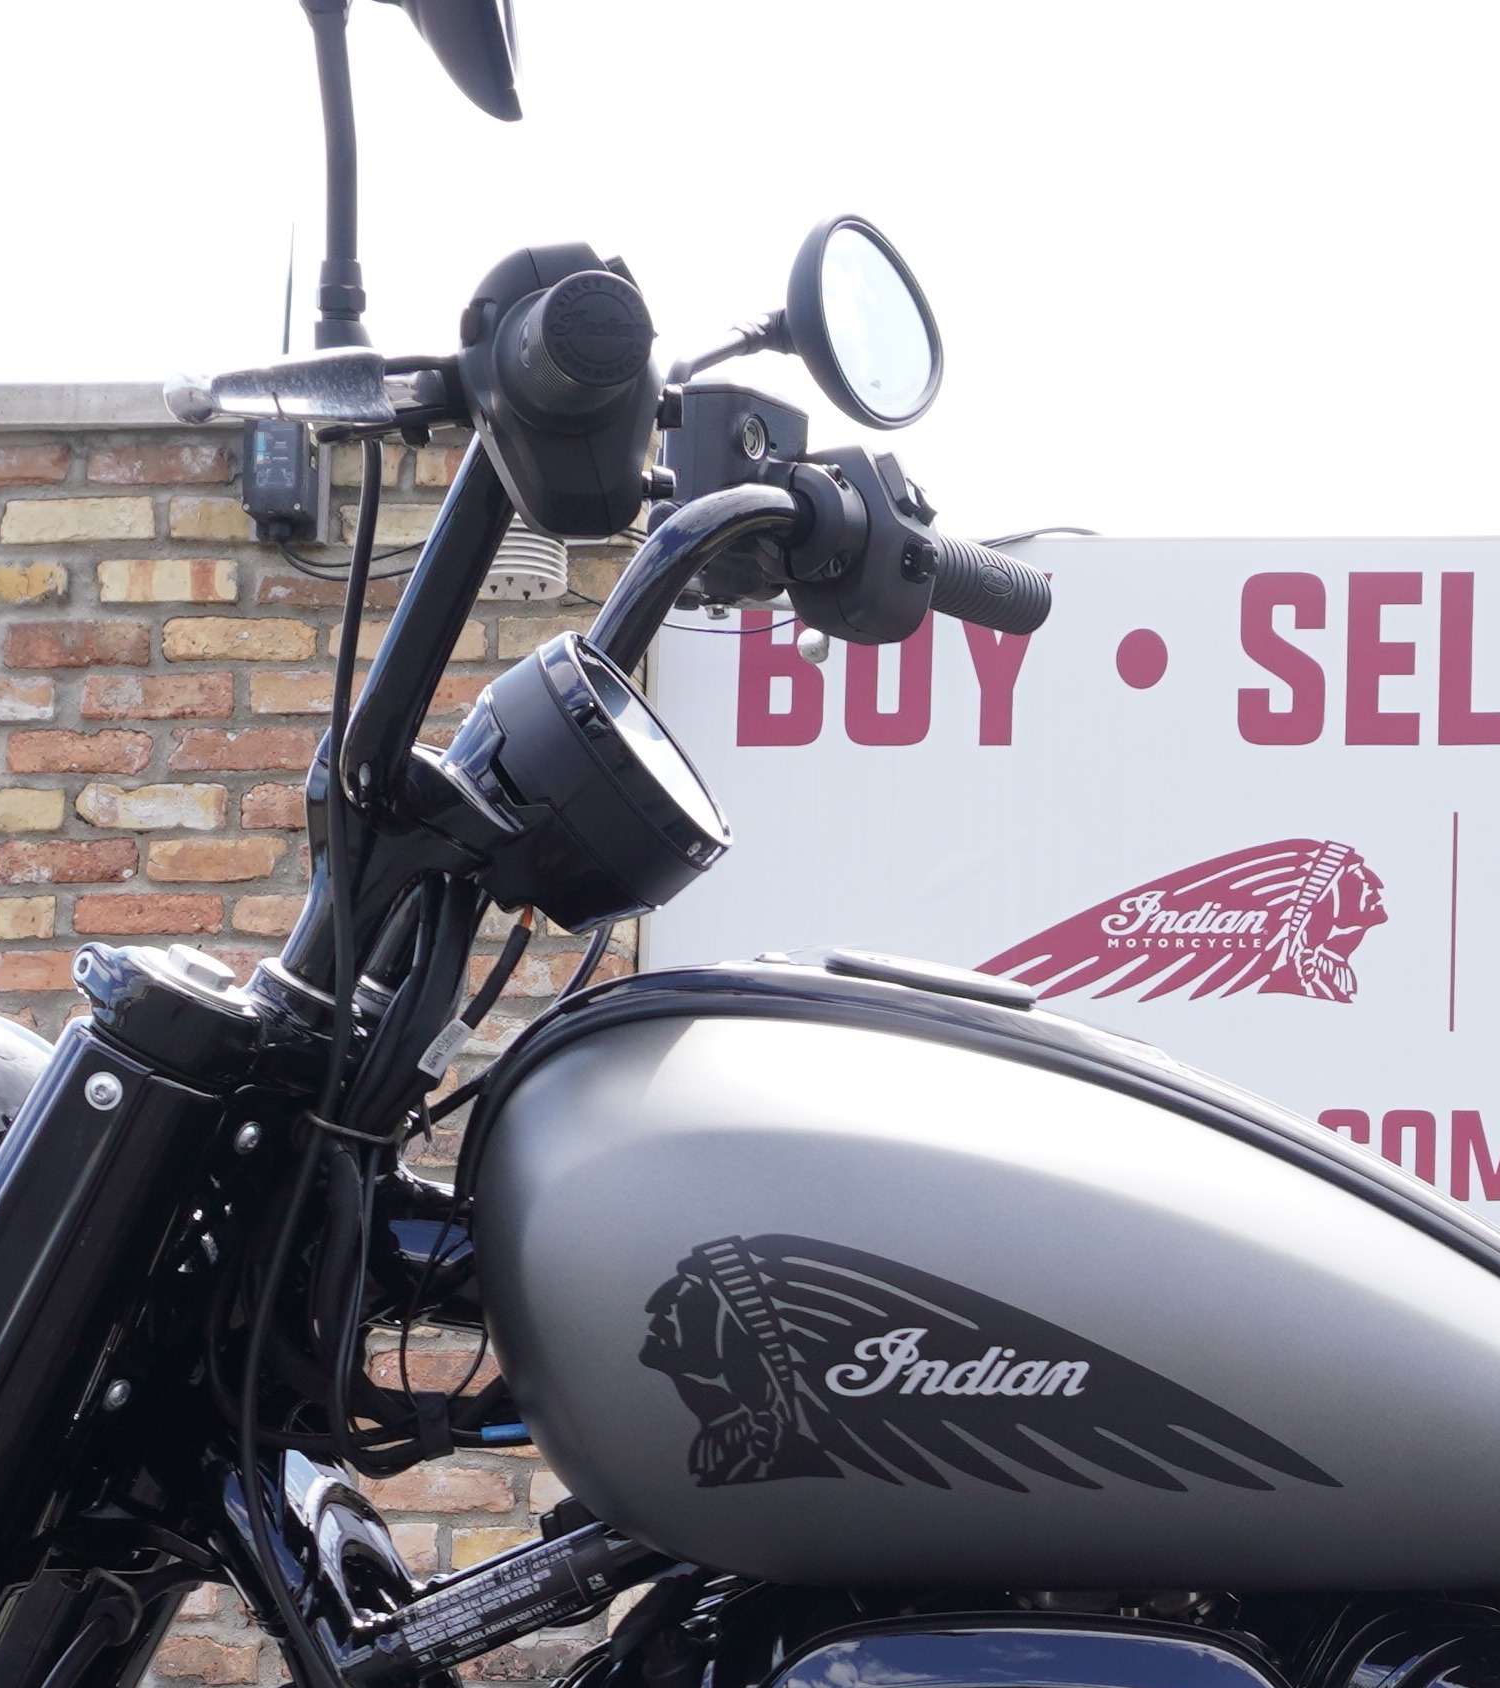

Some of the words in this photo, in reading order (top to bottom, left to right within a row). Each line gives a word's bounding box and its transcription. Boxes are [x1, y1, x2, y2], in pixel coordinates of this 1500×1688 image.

[737, 573, 1053, 746] BUY
[1100, 890, 1266, 936] Indian
[1107, 938, 1263, 949] MOTORCYCLE
[824, 1327, 1090, 1399] Indian
